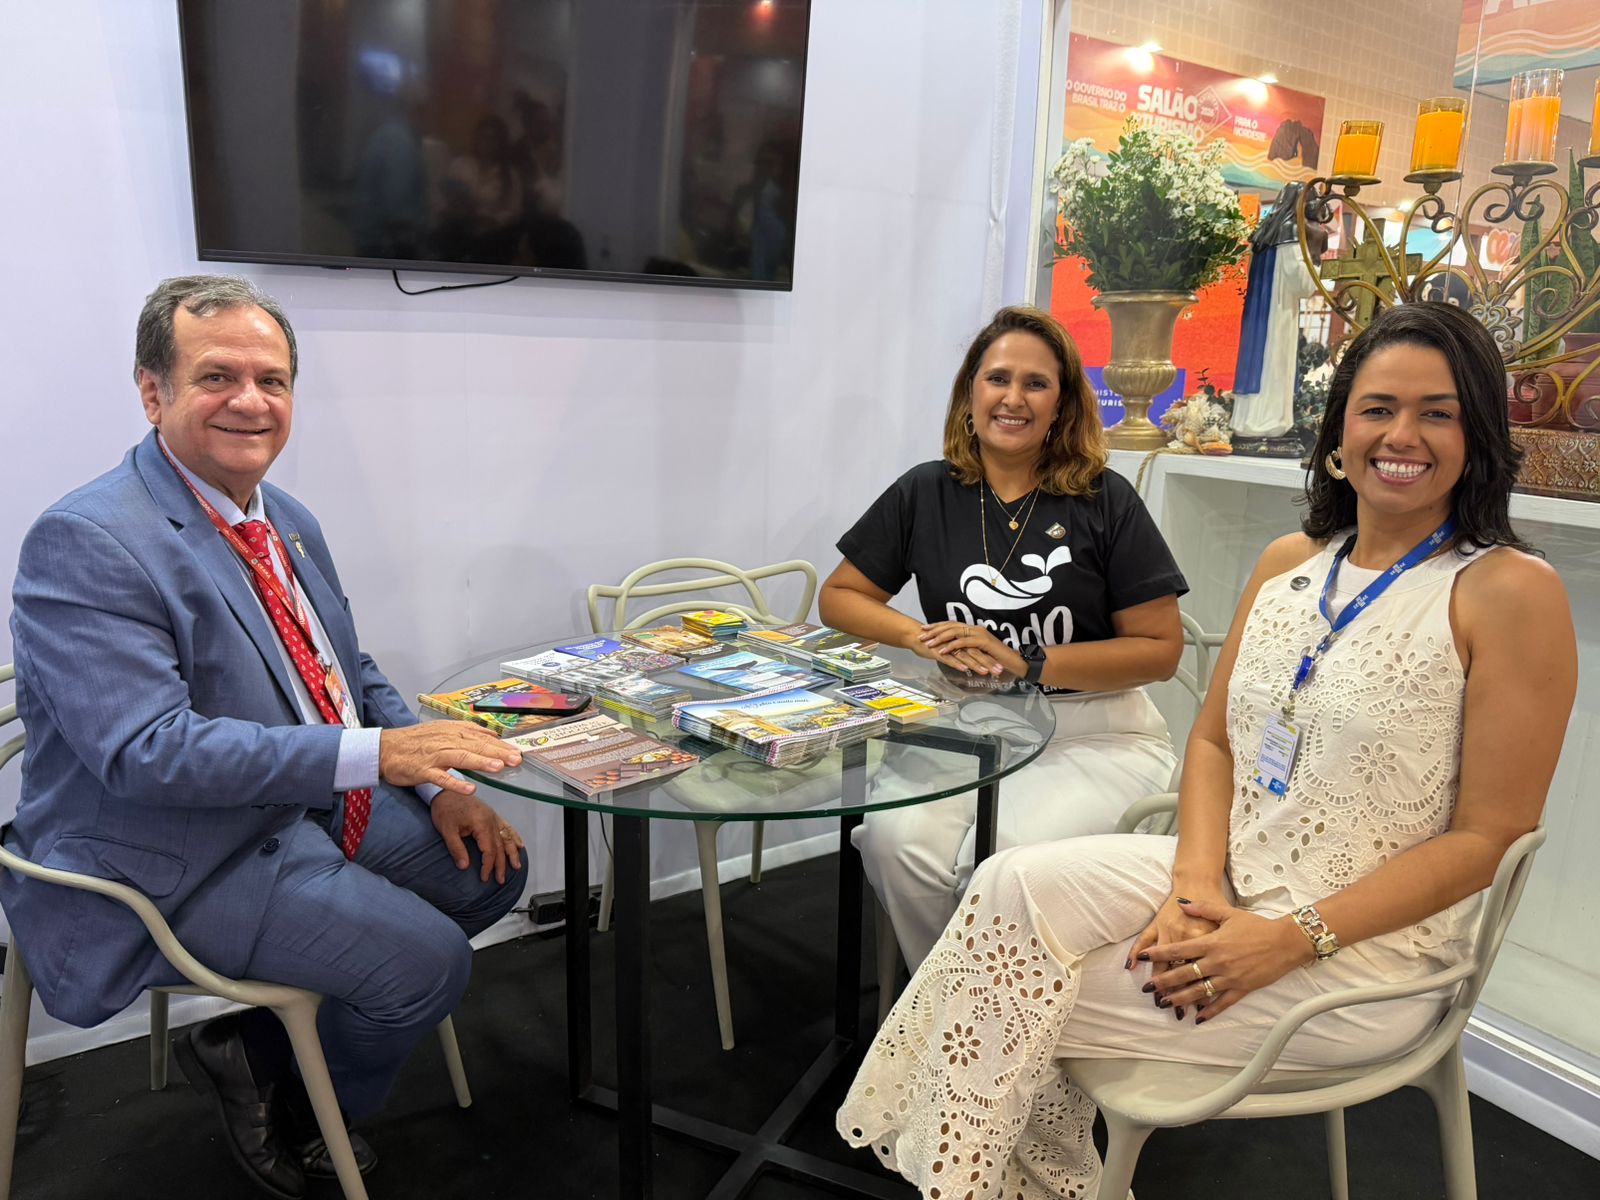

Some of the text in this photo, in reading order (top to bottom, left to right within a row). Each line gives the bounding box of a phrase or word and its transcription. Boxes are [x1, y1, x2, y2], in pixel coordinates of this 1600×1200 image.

[1066, 79, 1127, 102] O GOVERNO DO
[1072, 93, 1126, 113] BRASIL TRAZ O
[1137, 84, 1198, 121] SALÃO
[1251, 119, 1258, 129] O
